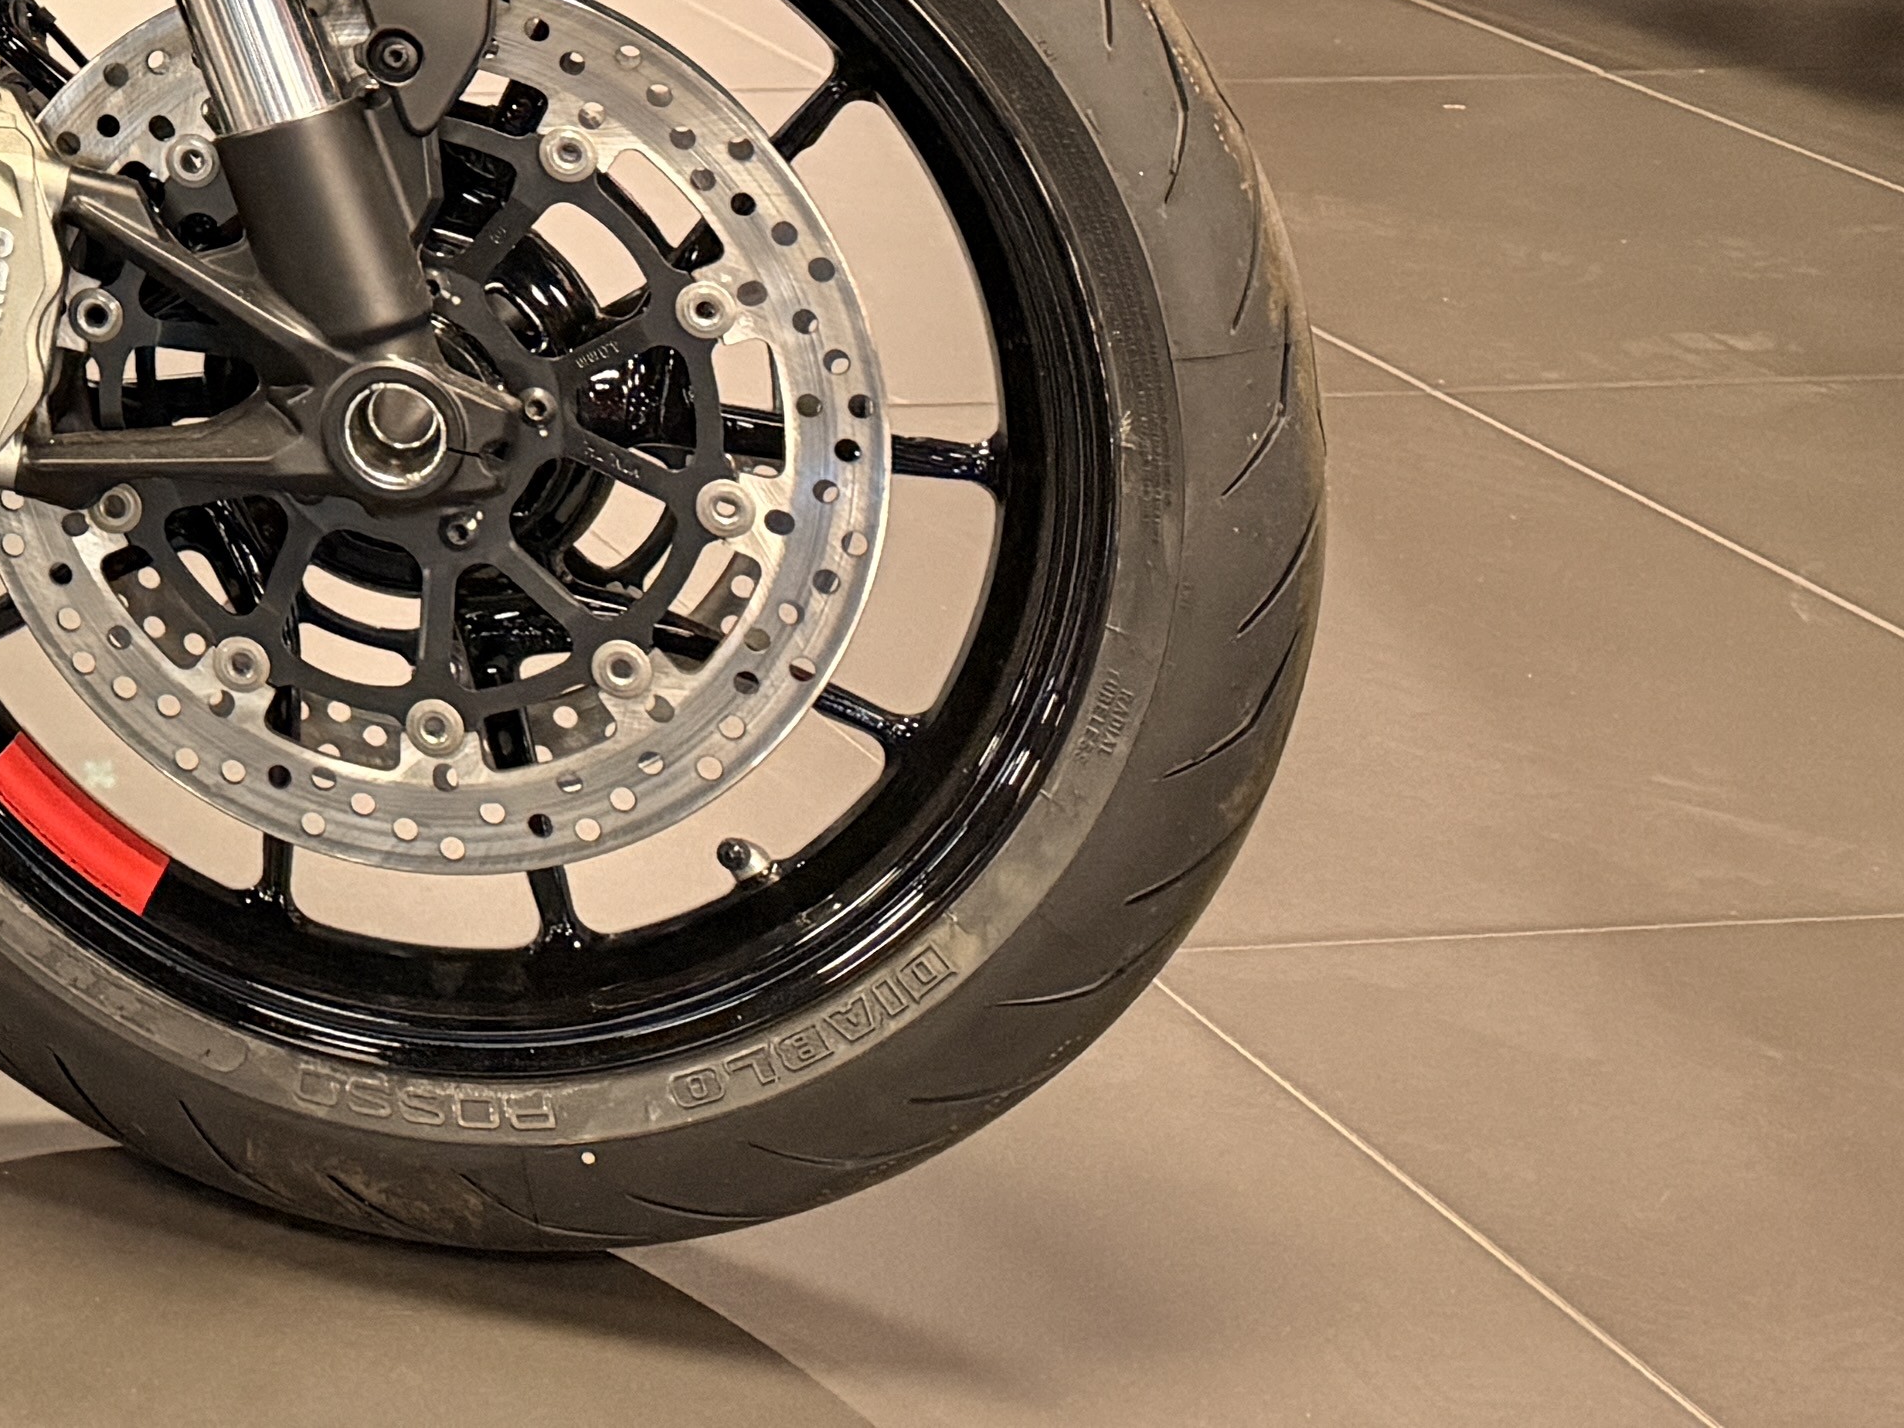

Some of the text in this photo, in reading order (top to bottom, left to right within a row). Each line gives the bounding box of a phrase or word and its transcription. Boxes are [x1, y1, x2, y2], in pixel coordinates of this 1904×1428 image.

[1099, 687, 1135, 755] RADIAL
[668, 942, 959, 1110] DIABLO
[292, 1062, 557, 1130] ROSSO
